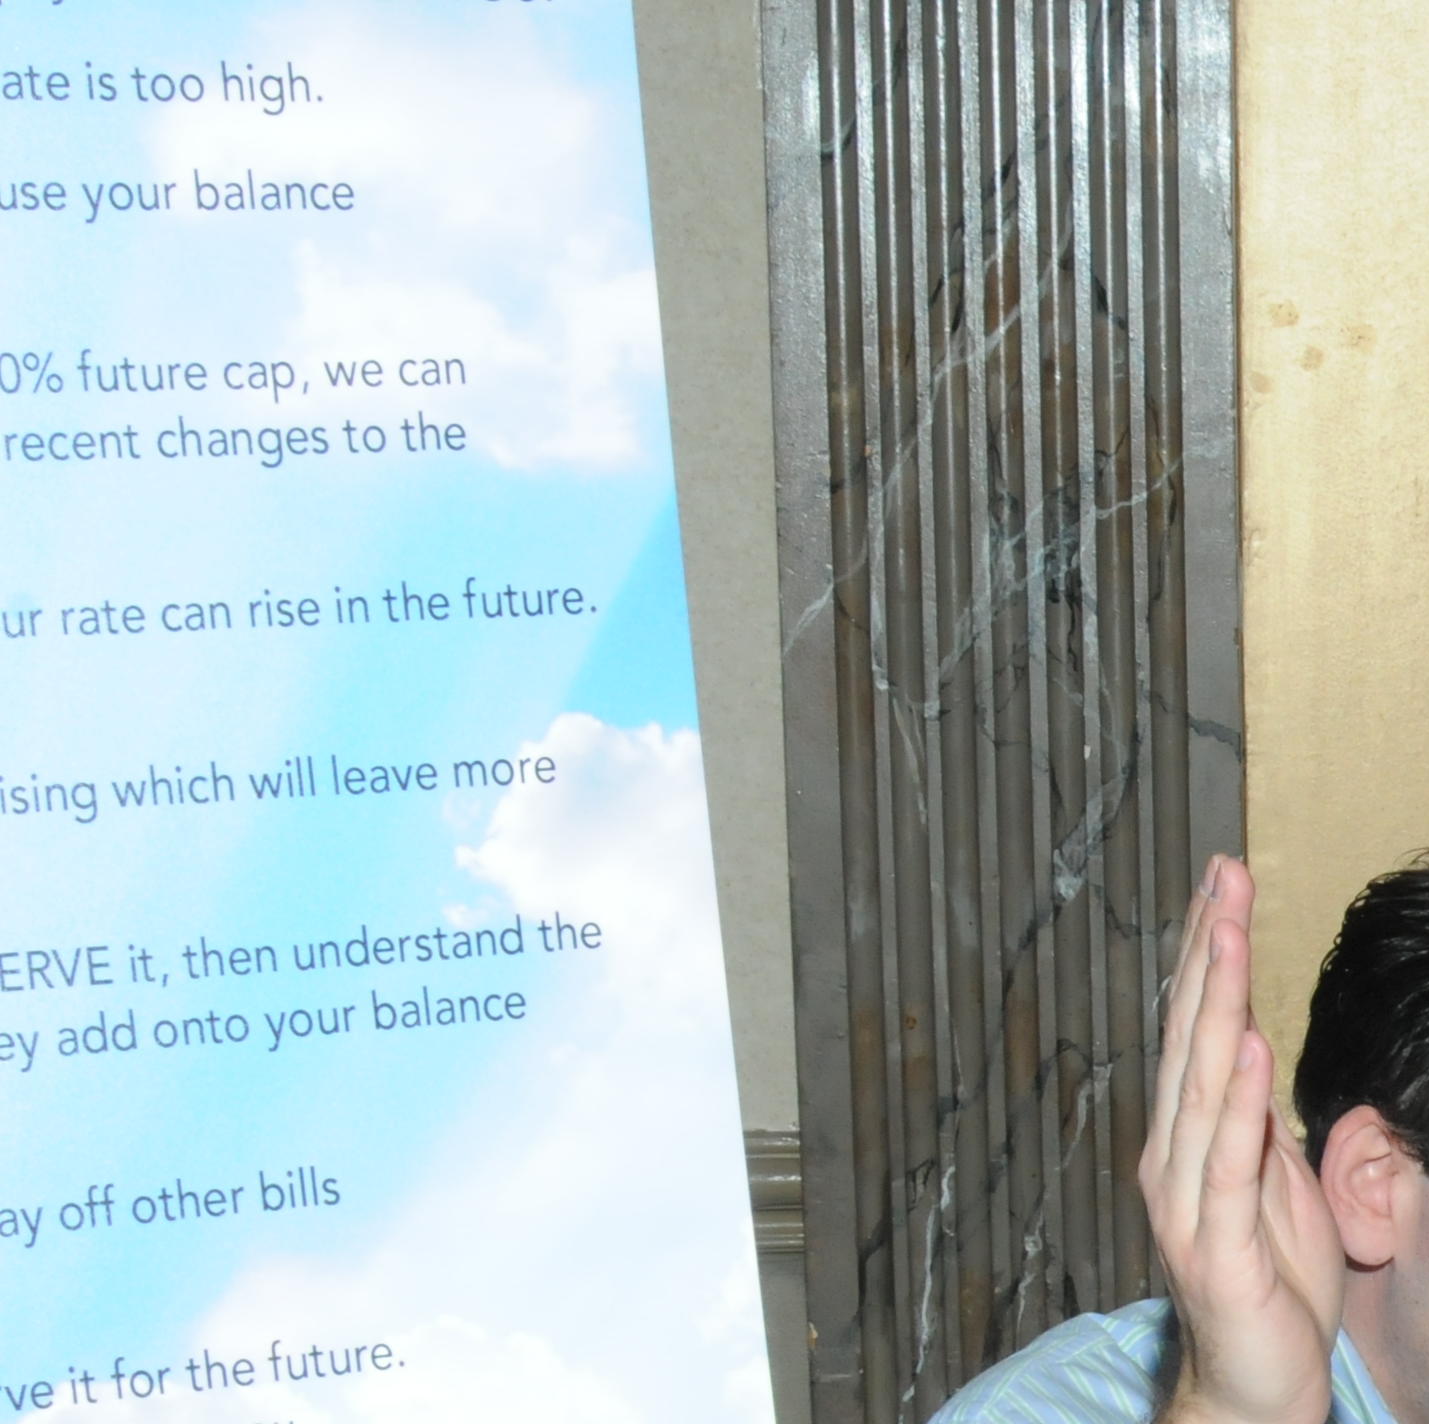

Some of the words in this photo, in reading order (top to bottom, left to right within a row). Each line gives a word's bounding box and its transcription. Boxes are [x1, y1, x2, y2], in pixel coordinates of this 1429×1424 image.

[2, 65, 71, 101] ate
[85, 61, 117, 102] is
[130, 67, 205, 102] too
[220, 59, 323, 116] high.
[81, 182, 177, 224] your
[194, 168, 355, 211] balance
[76, 348, 208, 393] future
[223, 361, 309, 404] cap,
[323, 359, 383, 388] we
[398, 358, 466, 387] can
[4, 424, 141, 462] recent
[157, 415, 330, 469] changes
[342, 420, 387, 454] to
[400, 411, 467, 453] the
[61, 600, 146, 636] rate
[161, 601, 232, 633] can
[249, 589, 321, 628] rise
[334, 586, 370, 624] in
[382, 581, 450, 623] the
[462, 576, 597, 619] future.
[111, 761, 235, 808] which
[248, 755, 316, 800] will
[331, 754, 438, 796] leave
[453, 756, 556, 788] more
[128, 943, 169, 988] it,
[182, 936, 278, 980] then
[293, 914, 524, 972] understand
[537, 911, 602, 953] the
[58, 1008, 138, 1057] add
[153, 1010, 250, 1049] onto
[264, 1005, 356, 1053] your
[371, 985, 526, 1031] balance
[59, 1183, 115, 1231] off
[131, 1178, 244, 1224] other
[259, 1165, 341, 1212] bills
[67, 1365, 98, 1404] it
[110, 1356, 171, 1399] for
[184, 1349, 255, 1392] the
[267, 1339, 405, 1382] future.
